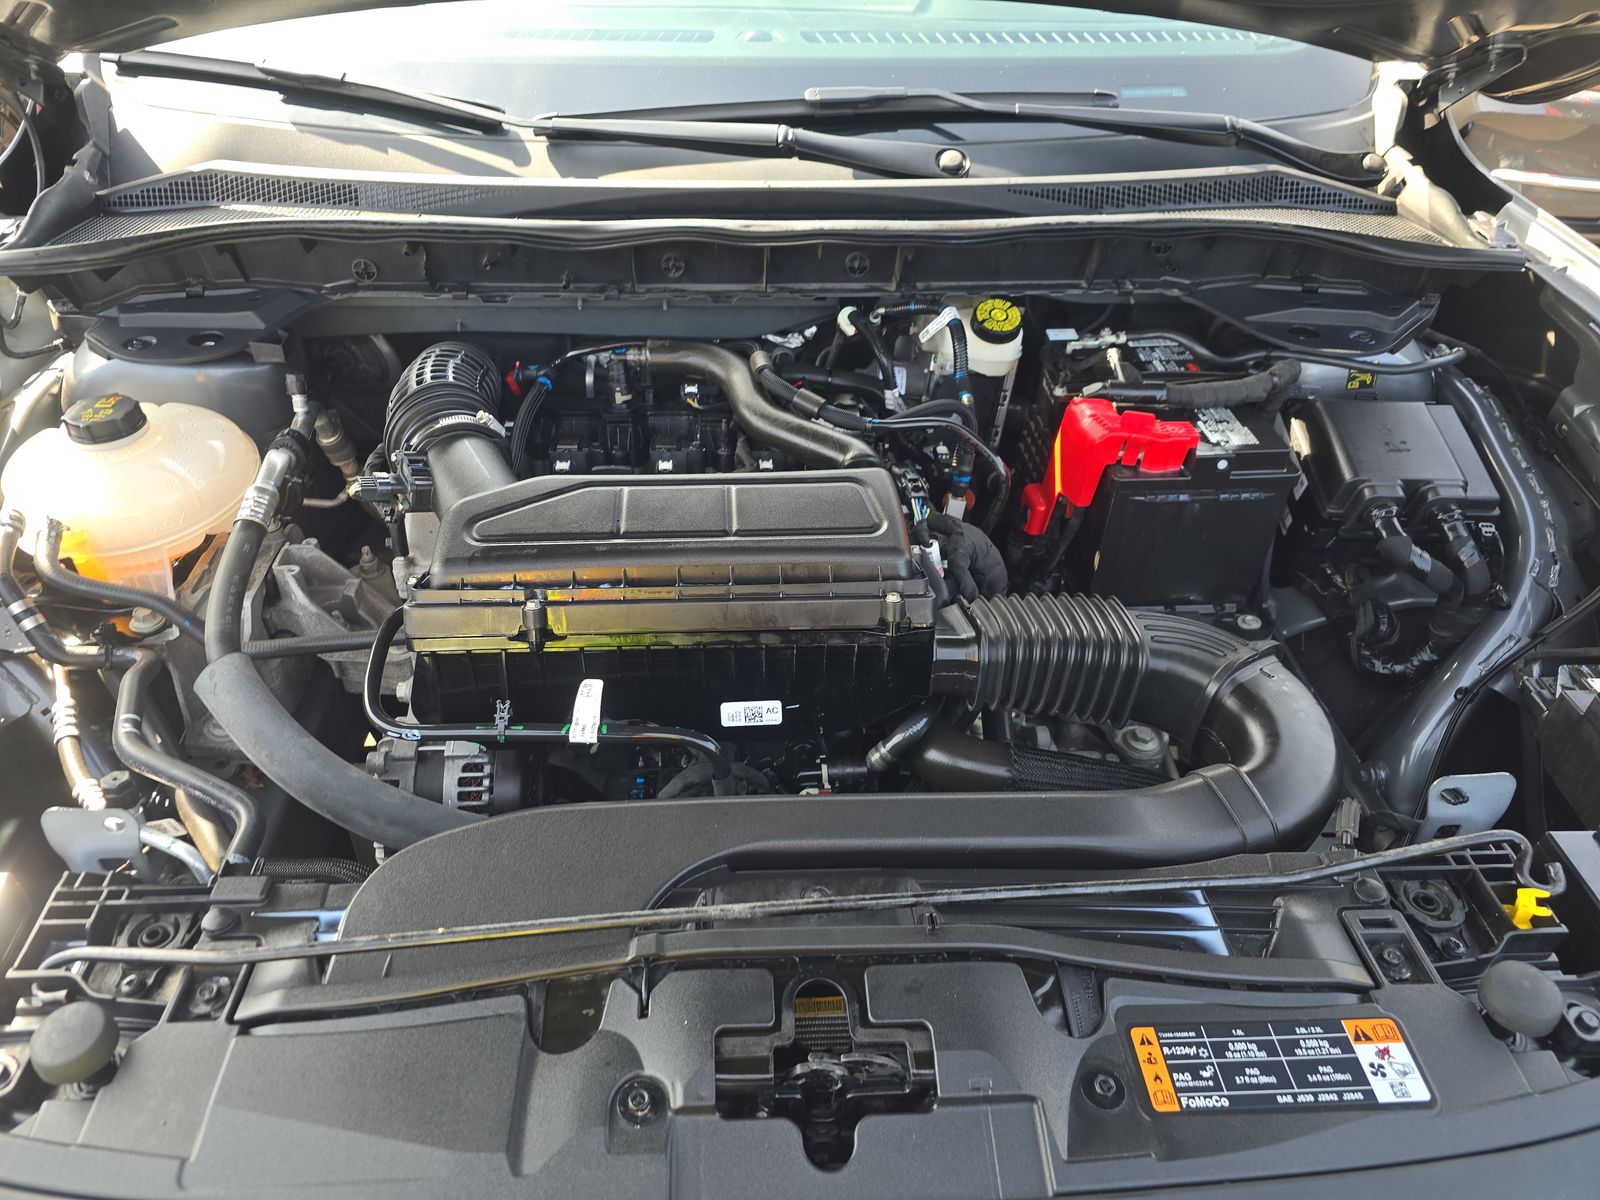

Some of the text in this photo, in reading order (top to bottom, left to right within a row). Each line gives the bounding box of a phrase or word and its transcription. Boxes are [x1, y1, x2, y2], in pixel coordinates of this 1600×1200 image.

[1162, 1046, 1197, 1056] R-1234yf
[1244, 1067, 1260, 1076] PAG
[1317, 1065, 1334, 1074] PAG
[1172, 1072, 1192, 1082] PAG
[1180, 1095, 1230, 1109] FoMoCo
[1276, 1094, 1294, 1104] SAE
